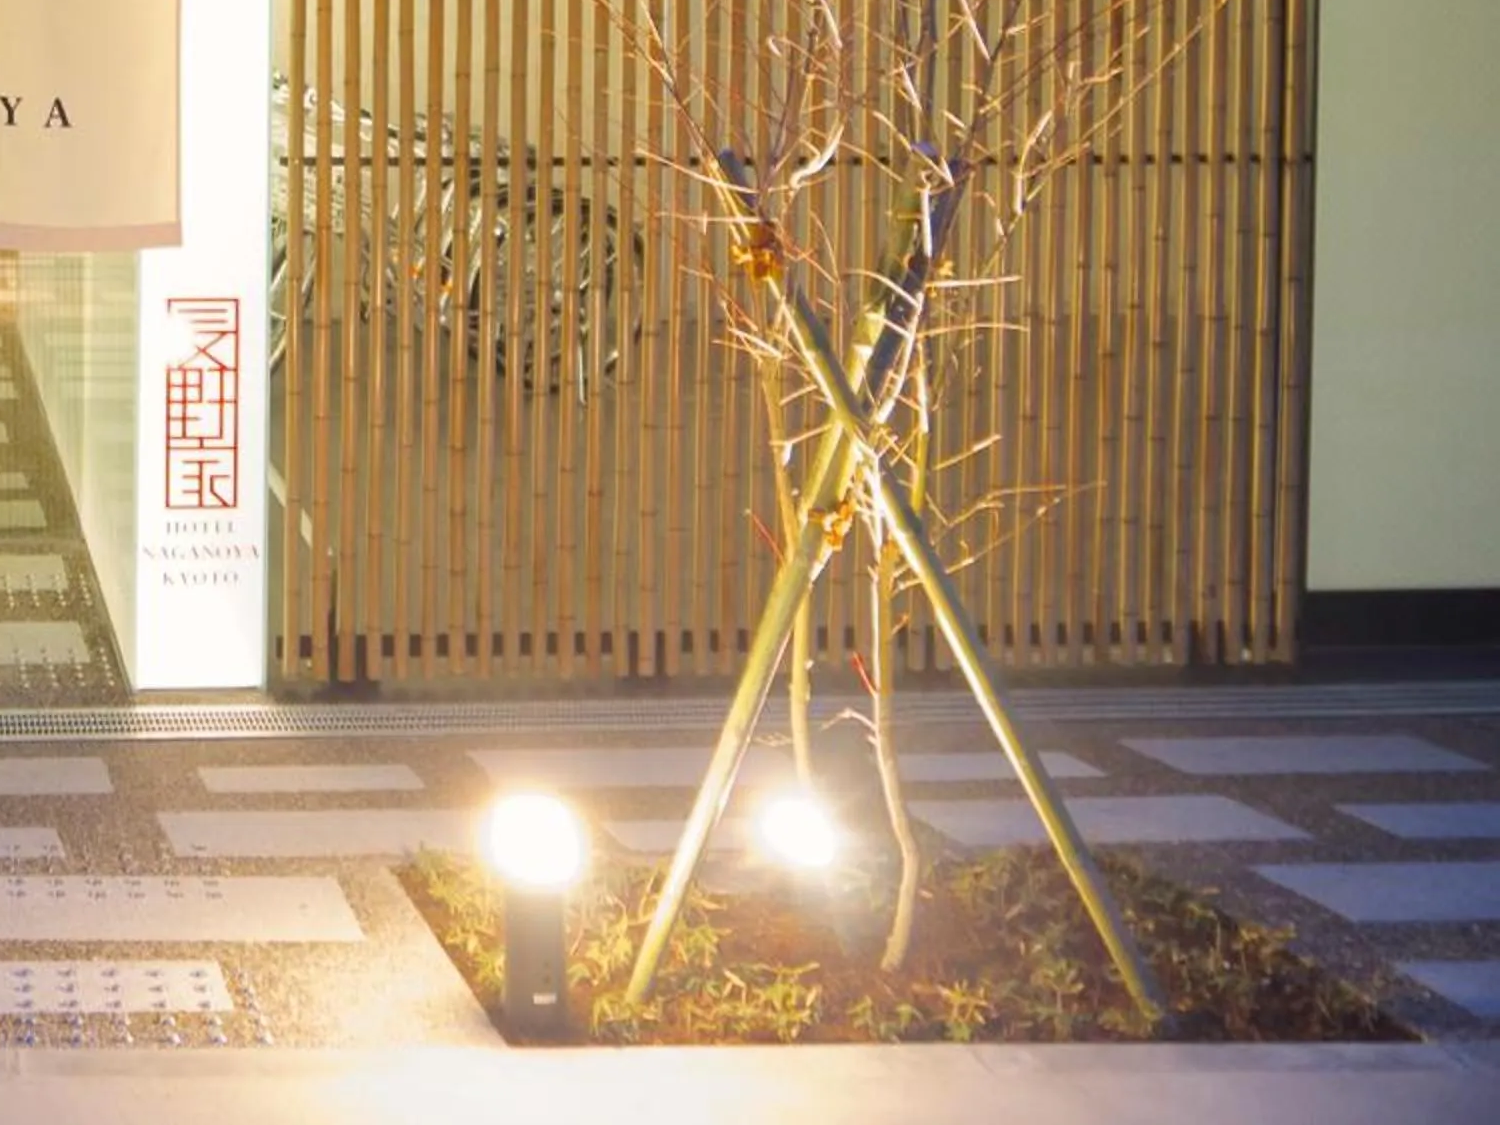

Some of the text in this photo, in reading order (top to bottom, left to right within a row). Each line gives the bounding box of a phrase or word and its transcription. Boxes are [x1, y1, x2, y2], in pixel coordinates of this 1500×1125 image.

[165, 521, 237, 535] HOTEL
[142, 544, 260, 560] NAGANOYA
[162, 571, 239, 586] KYOTO
